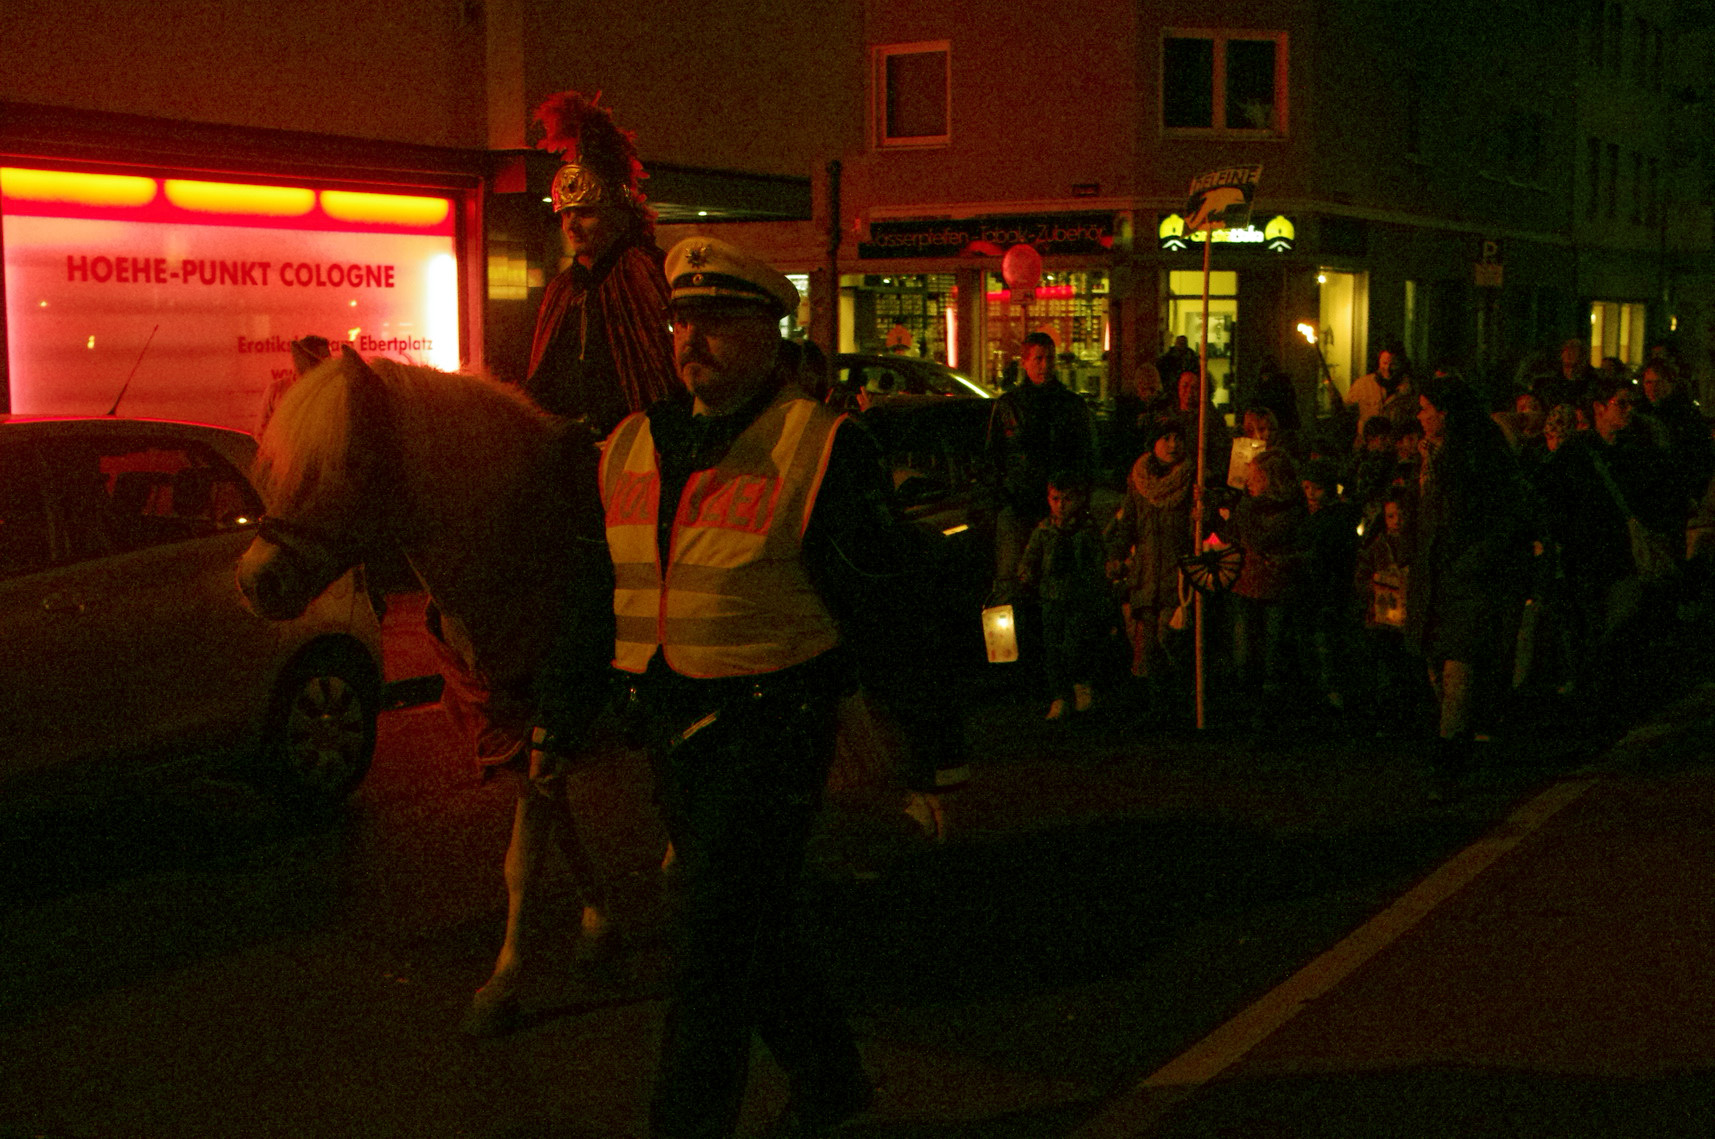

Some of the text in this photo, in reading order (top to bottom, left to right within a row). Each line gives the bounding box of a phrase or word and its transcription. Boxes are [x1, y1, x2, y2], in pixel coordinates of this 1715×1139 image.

[67, 255, 395, 289] HOEHE-PUNKT COLOGNE
[360, 335, 433, 355] Ebertplatz
